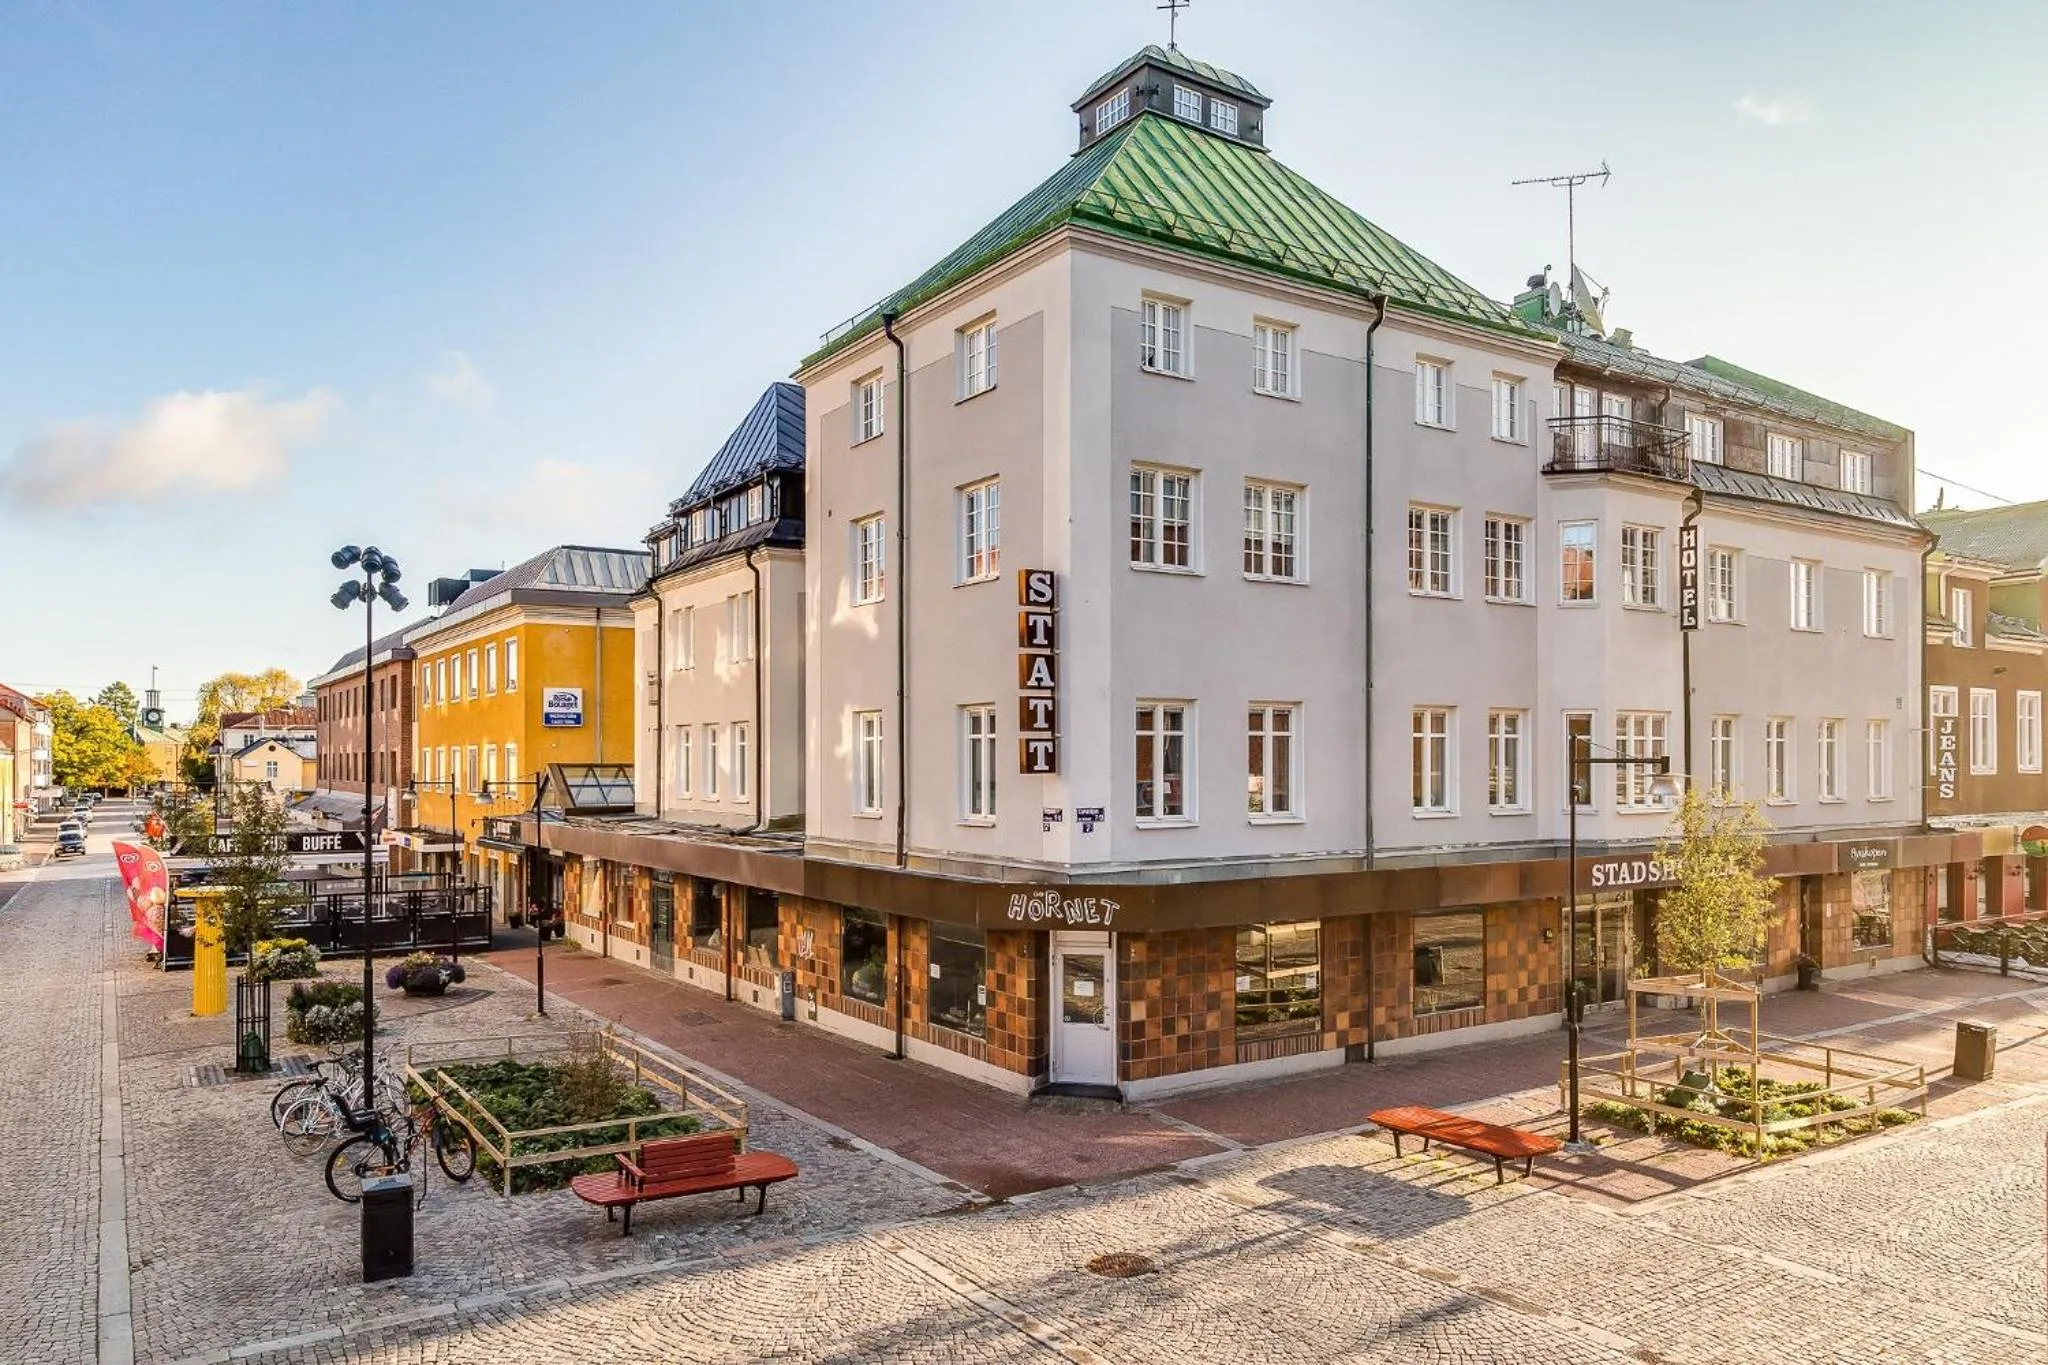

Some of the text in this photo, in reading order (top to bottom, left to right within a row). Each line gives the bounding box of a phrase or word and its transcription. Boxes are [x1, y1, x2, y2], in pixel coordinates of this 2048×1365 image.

[1681, 529, 1697, 627] HOTEL
[1027, 572, 1055, 771] STATT
[1938, 719, 1957, 799] JEANS
[302, 833, 342, 851] BUFFÉ
[1007, 890, 1120, 925] HÖRNET
